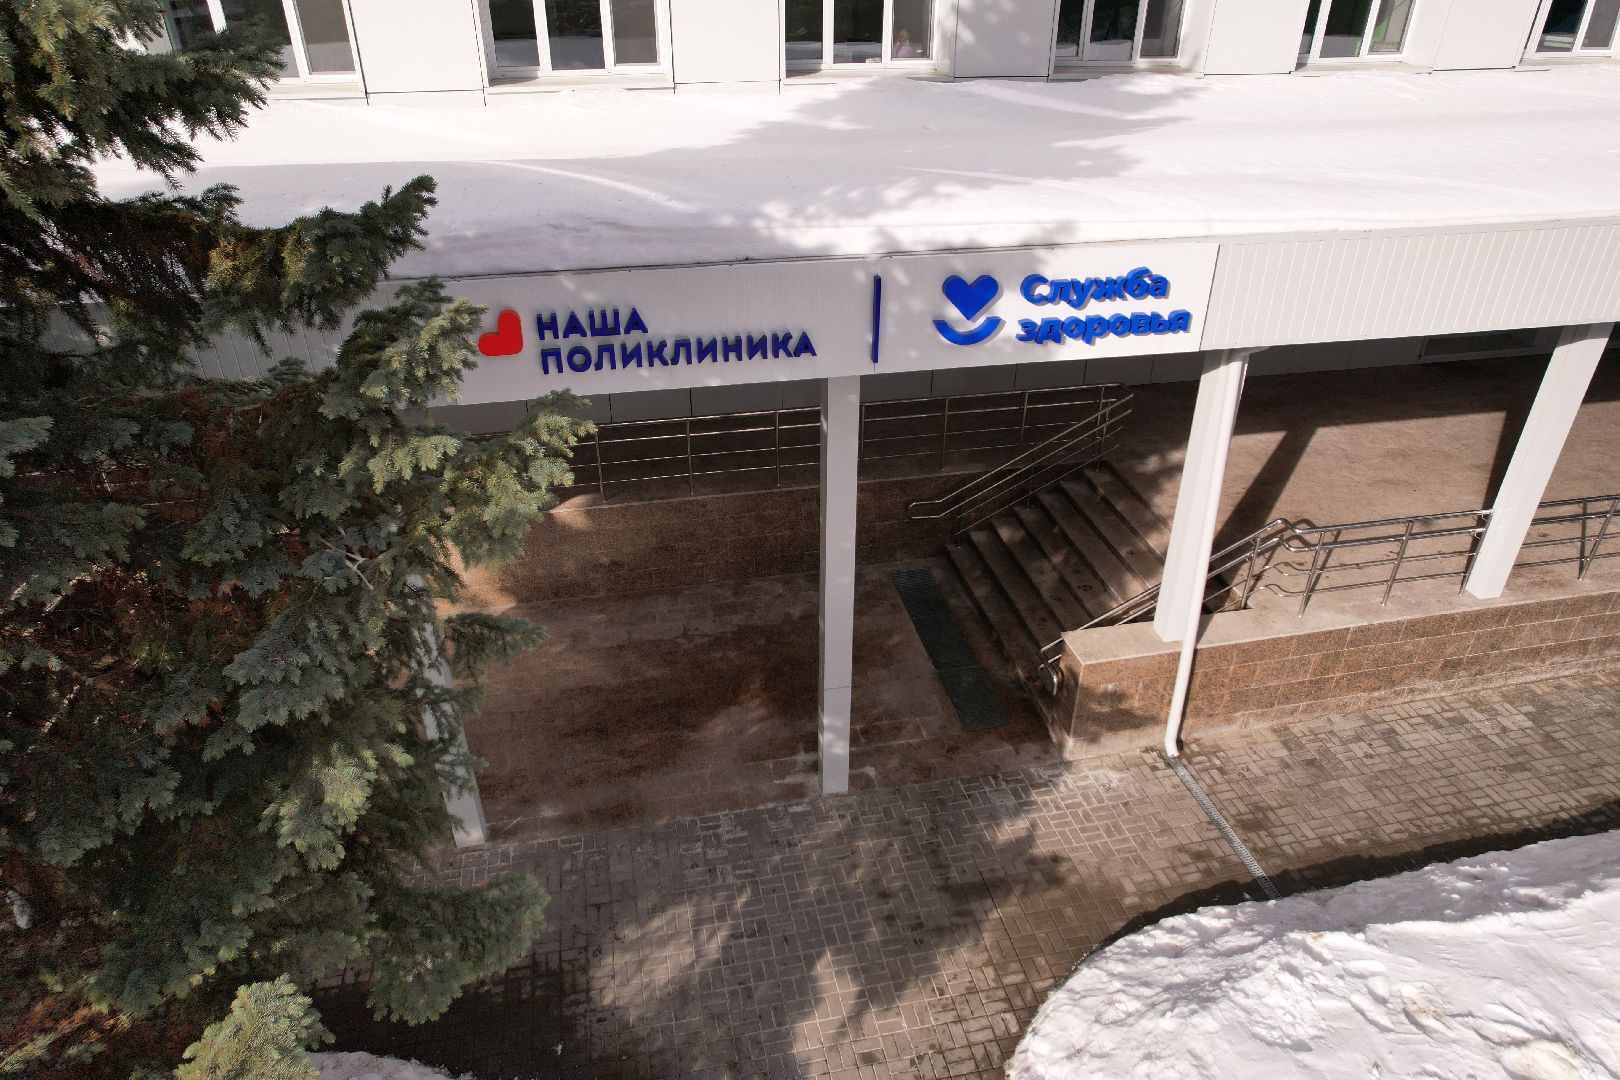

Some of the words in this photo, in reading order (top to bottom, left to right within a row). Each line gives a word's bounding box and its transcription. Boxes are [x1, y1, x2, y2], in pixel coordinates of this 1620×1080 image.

[1020, 266, 1171, 310] Служба
[536, 307, 649, 341] НАША
[1015, 308, 1193, 345] здоровья
[540, 330, 818, 375] ПОЛИКЛИНИКА
